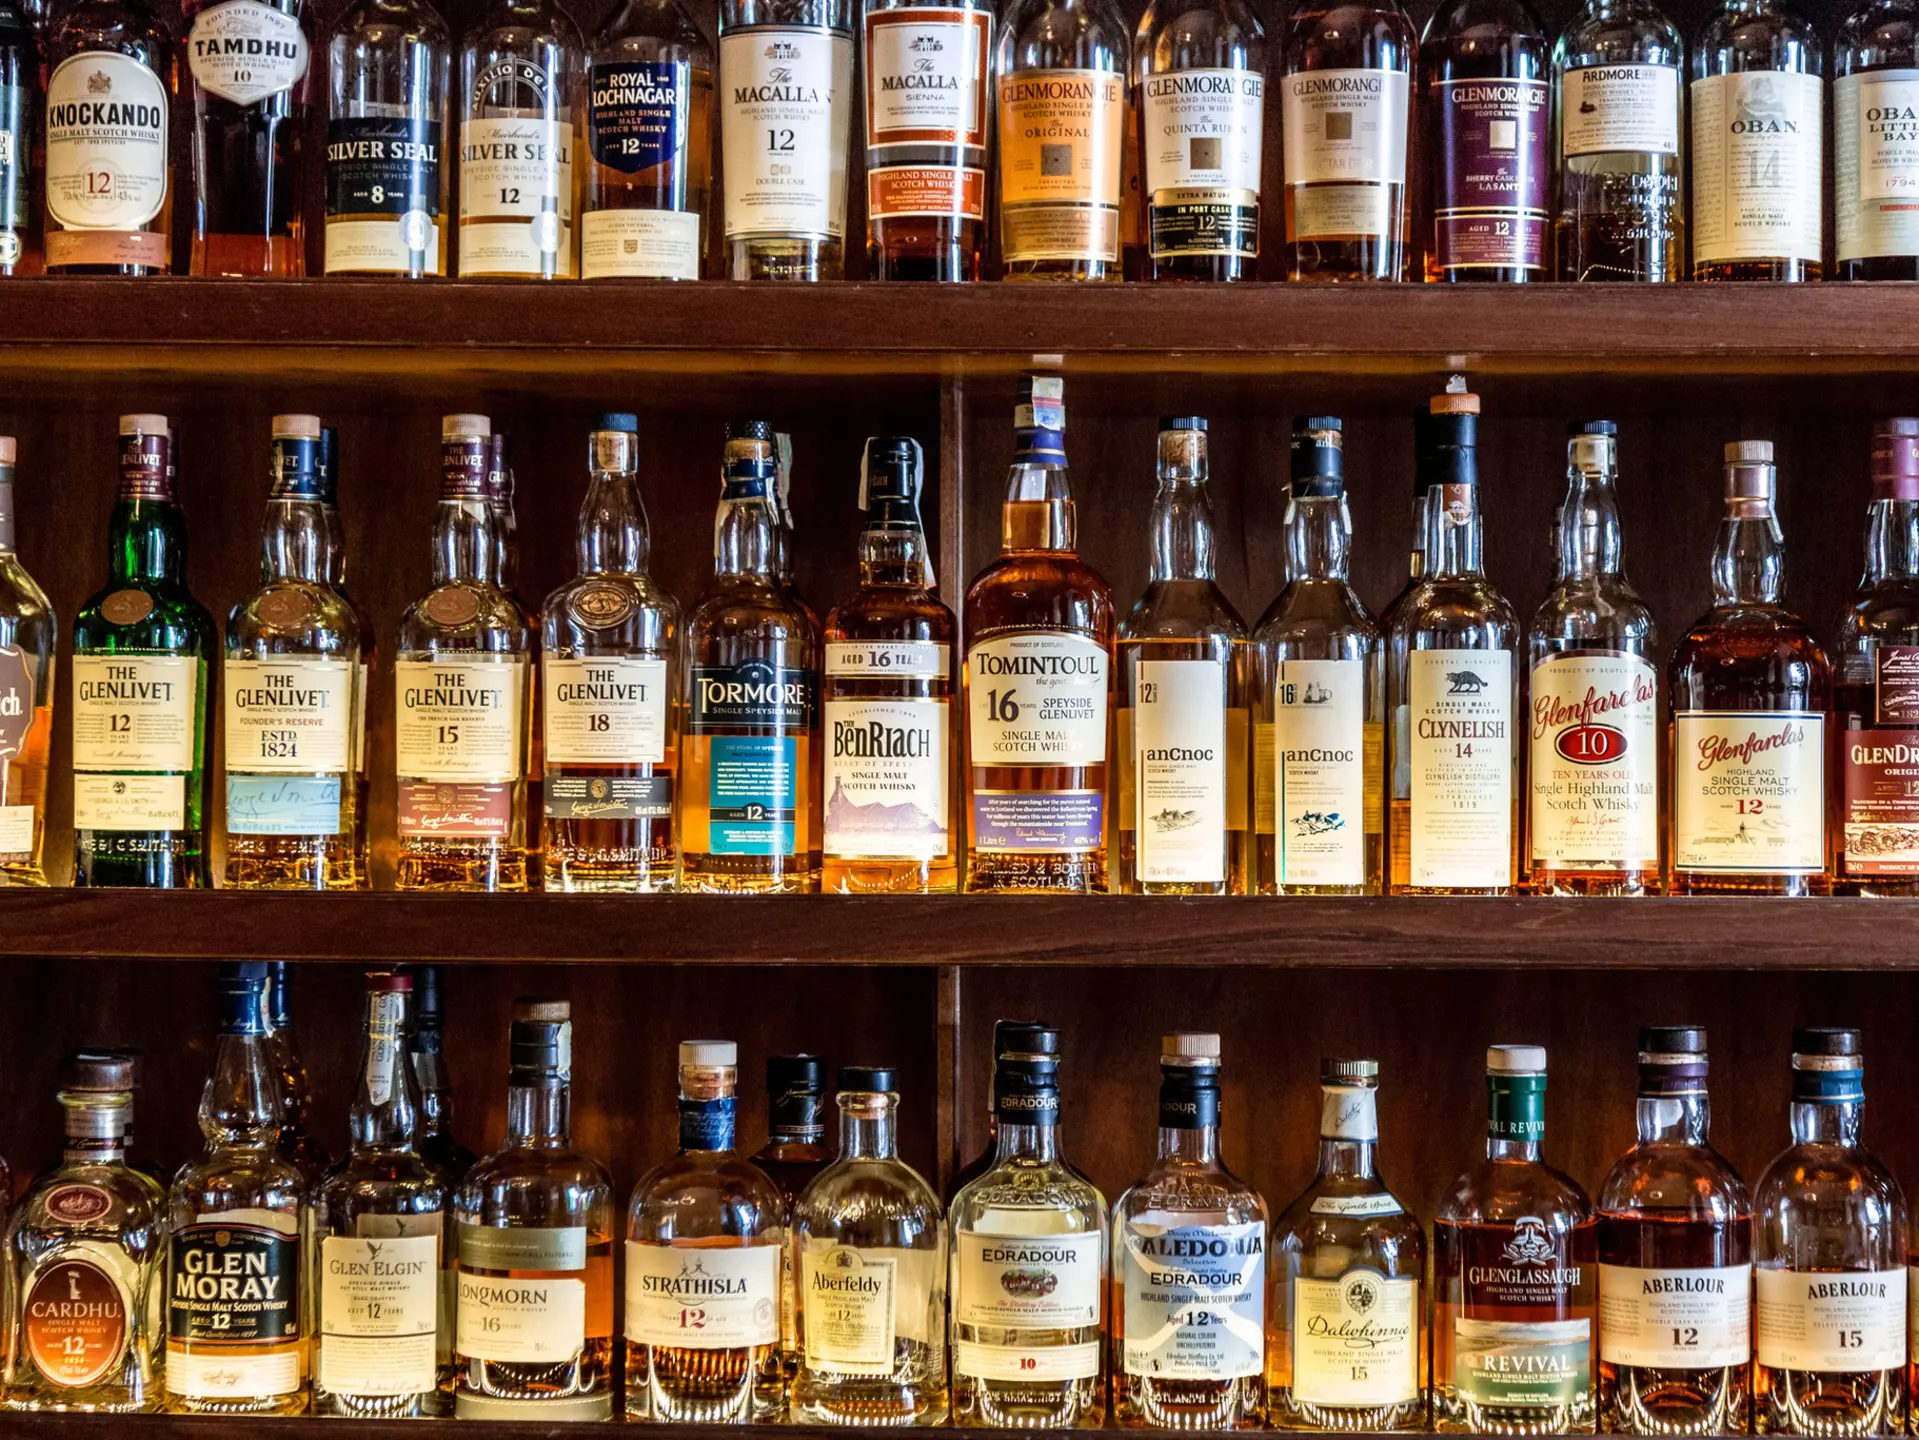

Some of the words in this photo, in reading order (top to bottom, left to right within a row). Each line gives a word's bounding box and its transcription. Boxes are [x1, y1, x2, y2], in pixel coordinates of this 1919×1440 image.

[195, 38, 296, 59] TAMDHU
[911, 58, 934, 73] The
[610, 73, 655, 87] ROYAL
[767, 68, 792, 84] The
[881, 75, 966, 91] MACALLA
[1583, 69, 1640, 82] ARDMORE
[1293, 78, 1385, 96] GLENMORANGI
[593, 88, 675, 107] LOCHNAGAR
[1452, 87, 1545, 104] GLENMORANGIE
[50, 102, 160, 128] KNOCKANDO
[639, 109, 671, 117] SINGLE
[1170, 105, 1205, 113] SCOTCH
[70, 128, 90, 136] MALT
[93, 128, 127, 136] SCOTCH
[1025, 127, 1089, 138] ORIGINAL
[1164, 124, 1207, 136] QUINTA
[1212, 124, 1247, 134] RUN
[1731, 120, 1797, 134] OBAN
[768, 129, 794, 150] 12
[1884, 133, 1918, 141] BAY
[328, 141, 384, 160] SILVER
[391, 142, 437, 162] SEAL
[462, 144, 518, 163] SILVER
[622, 138, 640, 154] 12
[922, 171, 951, 179] SINGLE
[1746, 150, 1783, 188] 14
[87, 172, 111, 193] 12
[892, 180, 925, 188] SCOTCH
[1886, 179, 1915, 187] 1794
[372, 186, 384, 203] 8
[500, 188, 520, 204] 12
[1189, 205, 1208, 213] PORT
[1199, 216, 1215, 230] 12
[1495, 222, 1509, 235] 12
[868, 652, 891, 667] 16
[976, 653, 1099, 675] TOMINTOUL
[107, 667, 137, 680] THE
[265, 675, 294, 687] THE
[434, 674, 465, 687] THE
[587, 670, 614, 682] THE
[80, 682, 172, 701] GLENLIVET
[237, 689, 329, 708] GLENLIVET
[406, 689, 499, 708] GLENLIVET
[558, 684, 648, 702] GLENLIVET
[697, 678, 804, 713] TORMORE
[1139, 683, 1152, 703] 12
[1280, 684, 1294, 704] 16
[745, 707, 785, 715] SPEYSIDE
[987, 688, 1020, 723] 16
[1043, 698, 1092, 708] SPEYSIDE
[1533, 674, 1654, 740] Glenfarclas
[240, 718, 283, 726] FOUNDER'S
[286, 718, 324, 726] RESERVE
[1039, 709, 1095, 720] GLENLIVET
[109, 715, 131, 732] 12
[588, 714, 610, 732] 18
[1418, 718, 1504, 739] CLYNELISH
[438, 726, 458, 744] 15
[1002, 731, 1040, 741] SINGLE
[1577, 731, 1608, 755] 10
[261, 742, 297, 758] 1824
[993, 742, 1036, 752] SCOTCH
[1146, 747, 1213, 762] anCnoc
[1455, 744, 1472, 758] 14
[1698, 723, 1804, 771] Glenfarclas
[1287, 749, 1353, 762] anCnoc
[1576, 771, 1609, 779] YEARS
[1711, 777, 1756, 786] SINGLE
[1760, 777, 1789, 786] MALT
[843, 782, 876, 790] SCOTCH
[879, 782, 916, 791] WHISKY
[1567, 782, 1629, 796] Highland
[1702, 787, 1750, 795] SCOTCH
[1547, 798, 1586, 810] Scotch
[1594, 798, 1640, 811] Whisky
[1735, 799, 1763, 815] 12
[747, 806, 763, 820] 12
[1001, 1098, 1057, 1109] EDRADOUR
[185, 1249, 267, 1275] GLEN
[982, 1249, 1076, 1263] EDRADOUR
[330, 1260, 369, 1275] GLEN
[374, 1261, 422, 1276] ELGIN
[812, 1271, 881, 1296] Aberfeldy
[1150, 1272, 1242, 1286] EDRADOUR
[1469, 1267, 1580, 1286] GLENGLASSAUGH
[176, 1272, 280, 1300] MORAY
[642, 1276, 747, 1297] STRATHISLA
[1486, 1286, 1524, 1294] HIGHLAND
[1526, 1287, 1550, 1295] SINGLE
[1642, 1278, 1724, 1295] ABERLOUR
[1807, 1282, 1887, 1299] ABERLOUR
[212, 1302, 232, 1311] MALT
[233, 1302, 261, 1311] SCOTCH
[263, 1300, 288, 1310] WHISKY
[1171, 1294, 1192, 1304] SINGLE
[1195, 1296, 1210, 1304] MALT
[32, 1301, 118, 1318] CARDHU
[367, 1303, 380, 1319] 12
[838, 1310, 850, 1321] 12
[212, 1313, 231, 1329] 12
[482, 1316, 501, 1332] 16
[679, 1308, 706, 1328] 12
[1166, 1315, 1184, 1324] Aged
[1187, 1311, 1209, 1326] 12
[1307, 1314, 1409, 1337] Dalwhinnie
[63, 1336, 85, 1354] 12
[1671, 1328, 1698, 1346] 12
[1838, 1330, 1863, 1349] 15
[1020, 1358, 1036, 1370] 10
[1484, 1355, 1571, 1372] REVIVAL
[1350, 1366, 1368, 1381] 15
